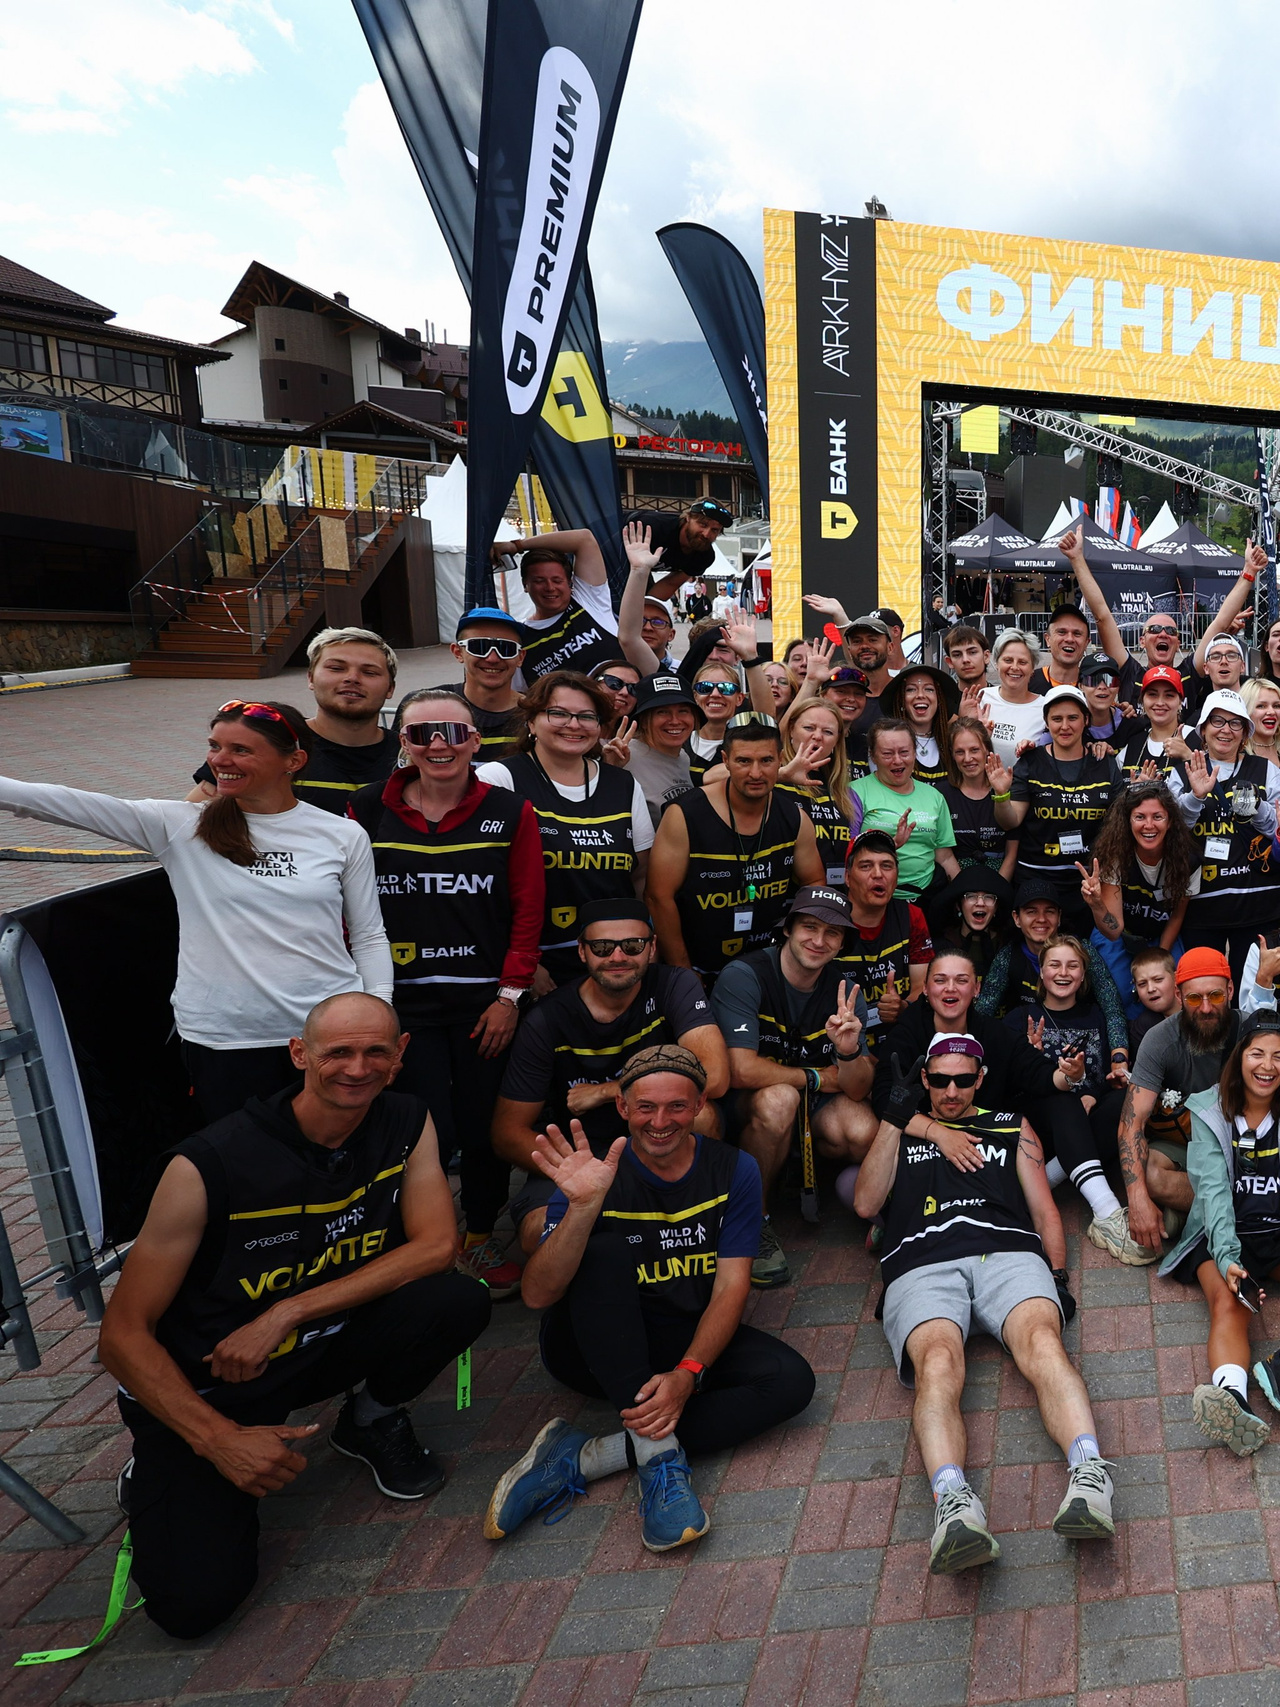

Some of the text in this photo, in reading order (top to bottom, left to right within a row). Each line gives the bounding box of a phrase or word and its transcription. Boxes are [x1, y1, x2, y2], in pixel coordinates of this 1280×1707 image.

[528, 79, 583, 324] PREMIUM
[821, 233, 850, 377] ARKHYZ
[639, 435, 742, 457] РЕСТОРАН
[830, 418, 849, 495] БАНК
[1085, 535, 1116, 546] WILD
[1152, 540, 1177, 550] WILD
[1145, 546, 1176, 555] TRAIL
[1192, 543, 1220, 553] WILD
[1014, 560, 1056, 568] WILDTRAIL.RU
[1111, 563, 1153, 572] WILDTRAIL.RU
[1120, 593, 1144, 603] WILD
[1121, 603, 1147, 614] TRAIL
[560, 627, 603, 663] TEAM
[532, 657, 553, 673] WILD
[480, 819, 505, 834] GRi
[569, 829, 600, 838] WILD
[572, 837, 605, 846] TRAIL
[257, 852, 292, 862] EAM
[247, 869, 286, 877] TRAIL
[1220, 866, 1251, 877] БАНК
[376, 874, 400, 885] ILD
[417, 872, 495, 895] TEAM
[811, 890, 847, 908] Haier
[1143, 905, 1173, 922] TEA
[421, 946, 477, 959] БАНК
[659, 1227, 692, 1241] WILD
[660, 1237, 697, 1251] TRAIL
